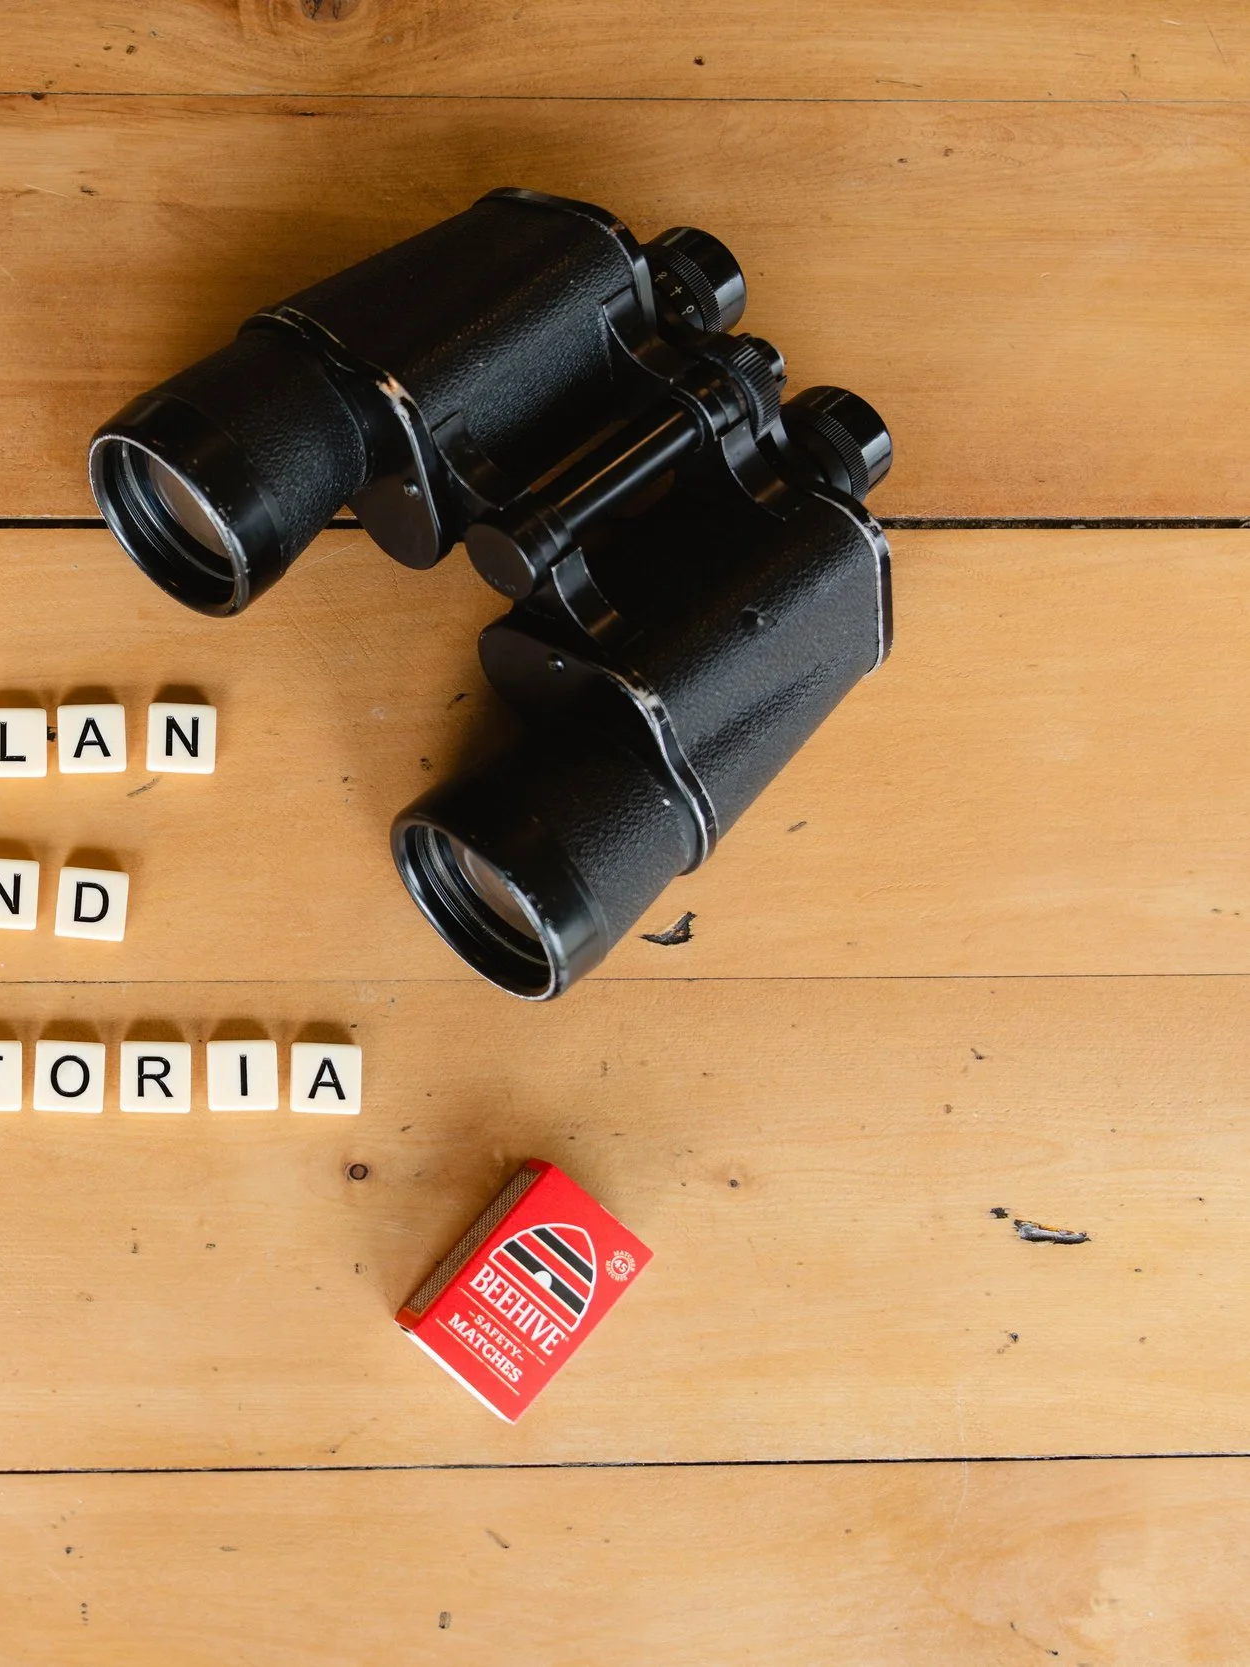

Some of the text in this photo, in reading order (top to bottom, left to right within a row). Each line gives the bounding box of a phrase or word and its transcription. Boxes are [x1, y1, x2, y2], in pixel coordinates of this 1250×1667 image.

[614, 1259, 628, 1273] 45
[468, 1263, 567, 1357] BEEHIVE
[474, 1314, 520, 1359] SAFETY
[447, 1312, 524, 1384] MATCHES
